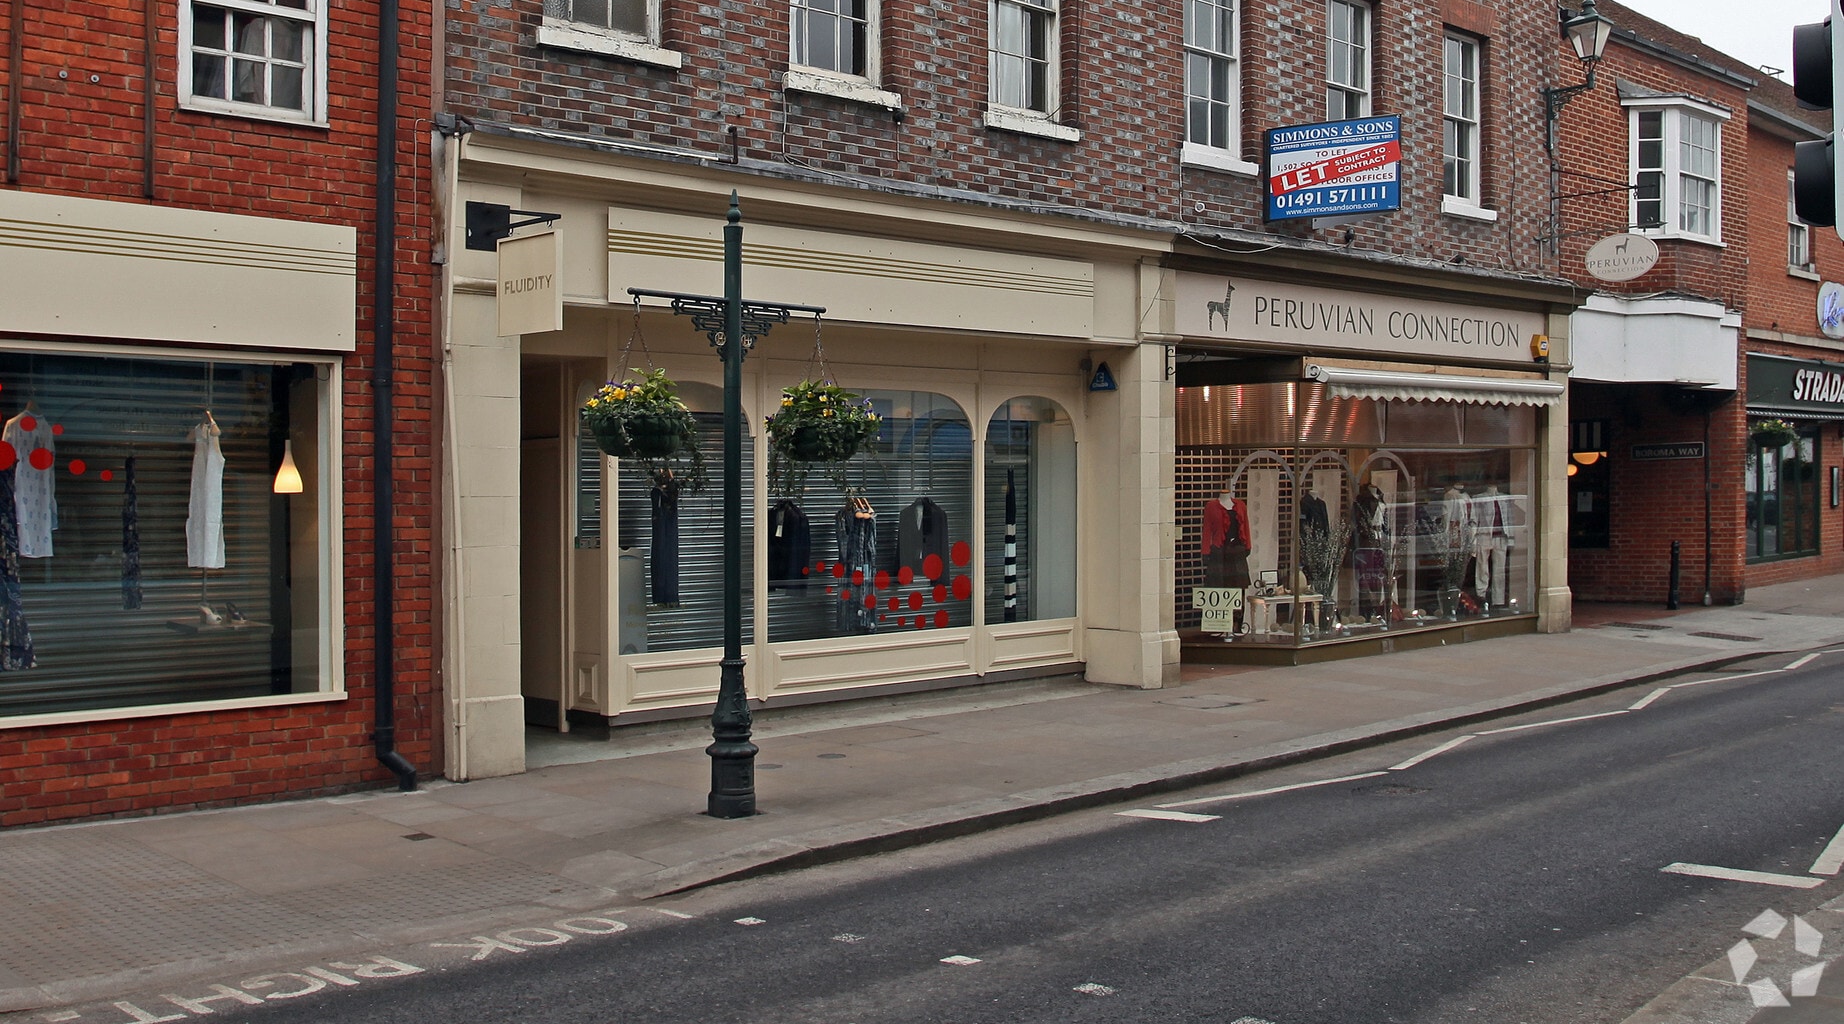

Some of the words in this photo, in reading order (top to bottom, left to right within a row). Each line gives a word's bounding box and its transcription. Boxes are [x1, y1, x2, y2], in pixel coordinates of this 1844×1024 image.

[1273, 126, 1338, 144] SIMMONS
[1341, 125, 1353, 136] &
[1356, 121, 1393, 134] SONS
[1316, 150, 1329, 158] TO
[1331, 148, 1348, 156] LET
[1334, 151, 1371, 166] SUBJECT
[1371, 146, 1386, 154] TO
[1337, 154, 1386, 173] CONTRACT
[1281, 162, 1329, 191] LET
[1355, 172, 1393, 182] OFFICES
[1276, 191, 1322, 209] 01491
[1328, 186, 1386, 204] 571111
[1286, 202, 1379, 216] www.simmonsandsons.com
[1589, 255, 1654, 269] PERUVIAN
[504, 274, 553, 295] FLUIDITY
[1254, 296, 1374, 336] PERUVIAN
[1388, 310, 1520, 348] CONNECTION
[1635, 448, 1675, 457] BOROMA
[1678, 447, 1700, 456] WAY
[1196, 590, 1242, 608] 30%
[1204, 609, 1229, 620] OFF
[430, 906, 694, 961] LOOK
